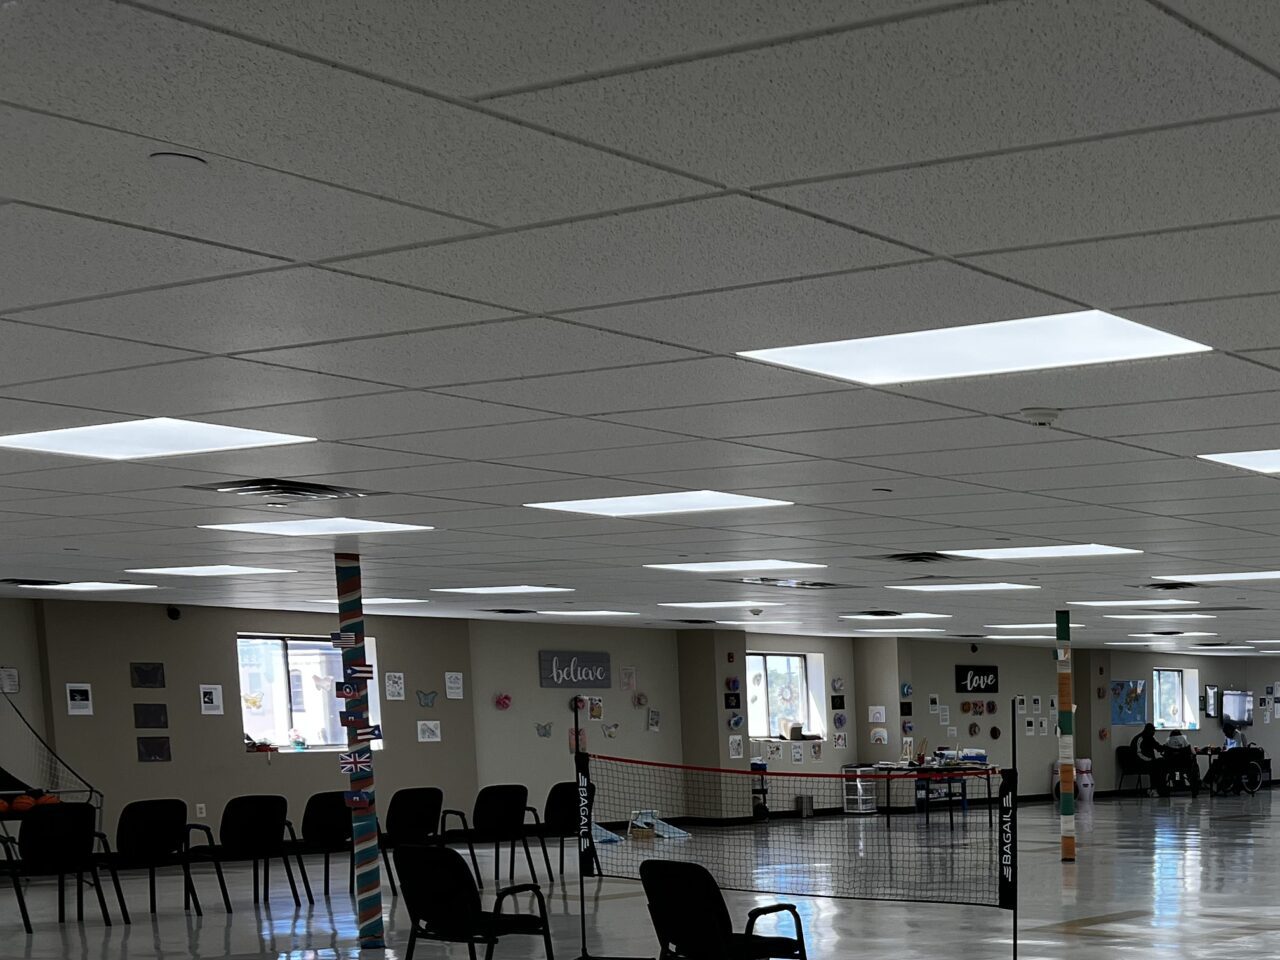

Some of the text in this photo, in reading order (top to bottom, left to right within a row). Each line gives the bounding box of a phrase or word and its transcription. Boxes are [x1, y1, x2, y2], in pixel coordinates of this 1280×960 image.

[548, 656, 606, 685] believe
[961, 670, 997, 691] love
[578, 787, 589, 837] BAGAIL
[1002, 809, 1013, 864] BAGAIL
